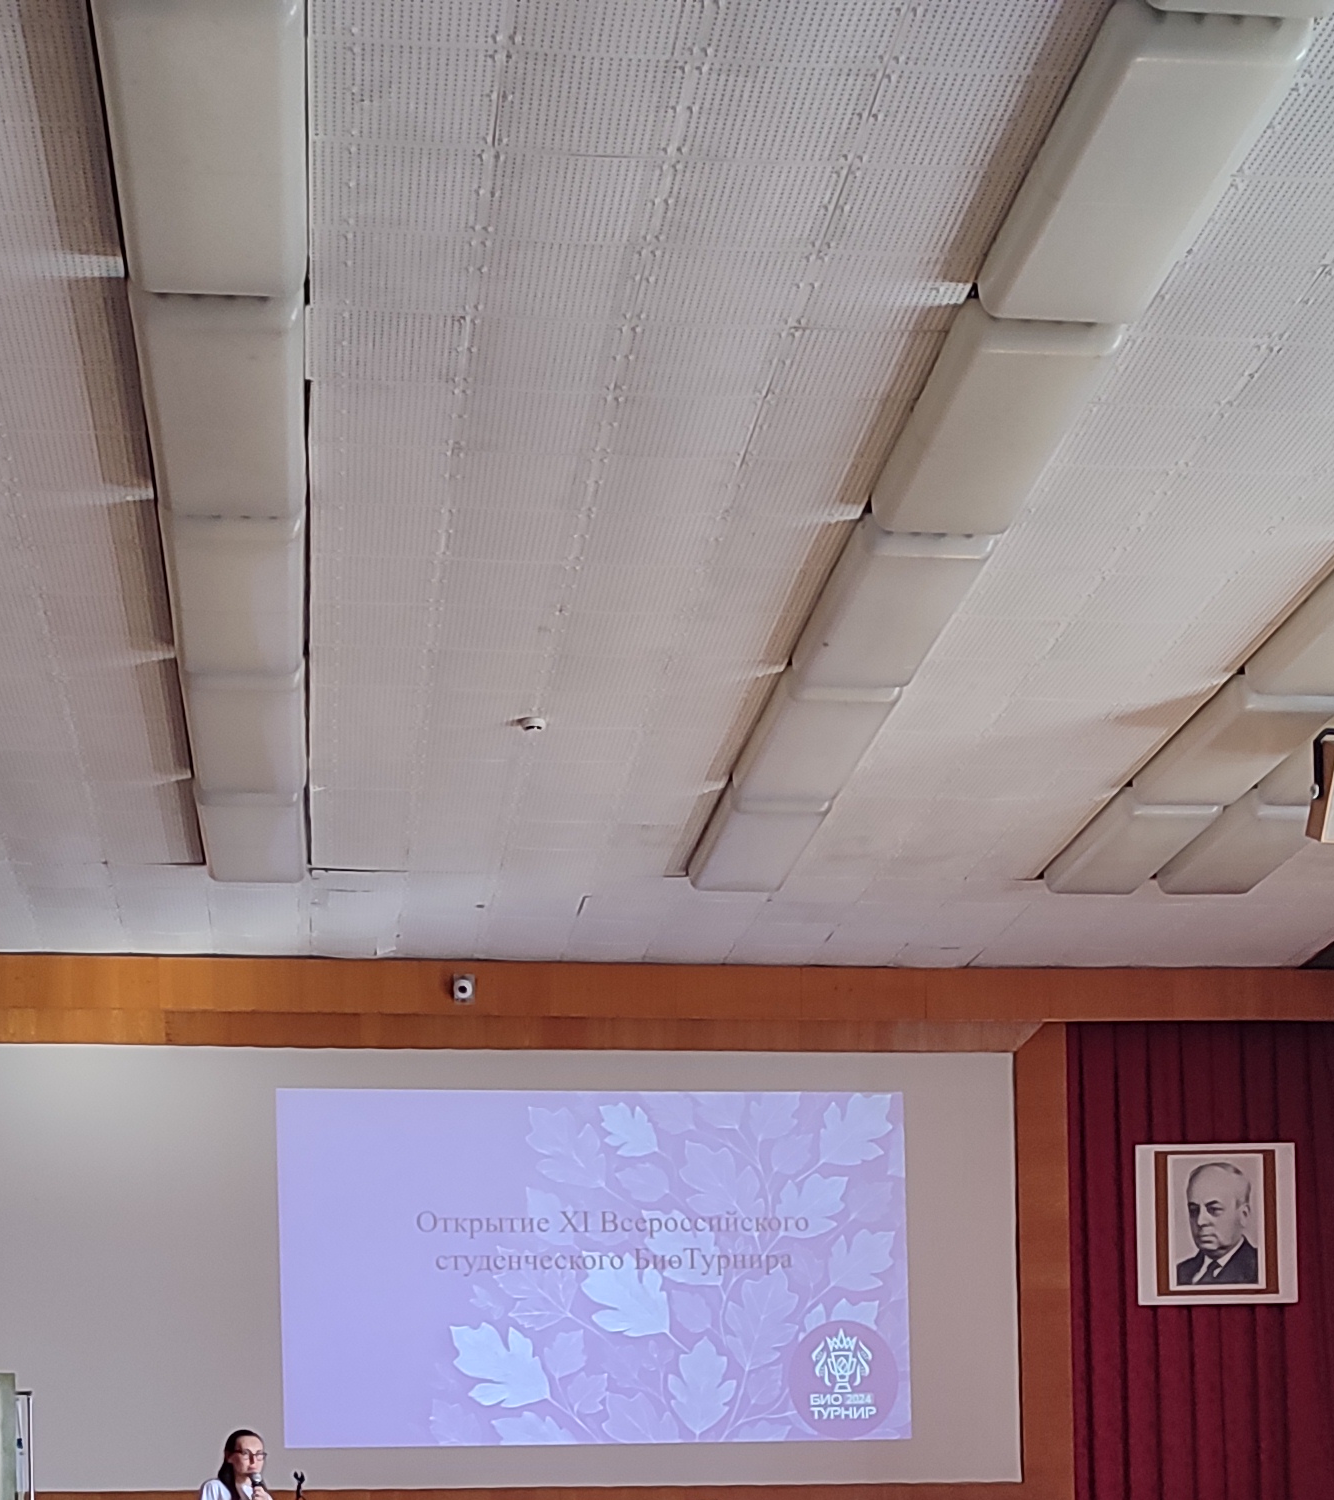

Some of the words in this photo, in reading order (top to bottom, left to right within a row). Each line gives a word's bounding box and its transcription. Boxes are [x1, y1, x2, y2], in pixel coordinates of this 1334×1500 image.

[416, 1210, 550, 1239] Открытие
[559, 1211, 589, 1233] XI
[600, 1209, 809, 1239] Всероссийского
[435, 1251, 624, 1277] студенческого
[634, 1247, 792, 1276] БиоТурнира
[810, 1393, 843, 1406] БИО
[845, 1393, 873, 1405] 2024
[810, 1406, 877, 1420] ТУРНИР
